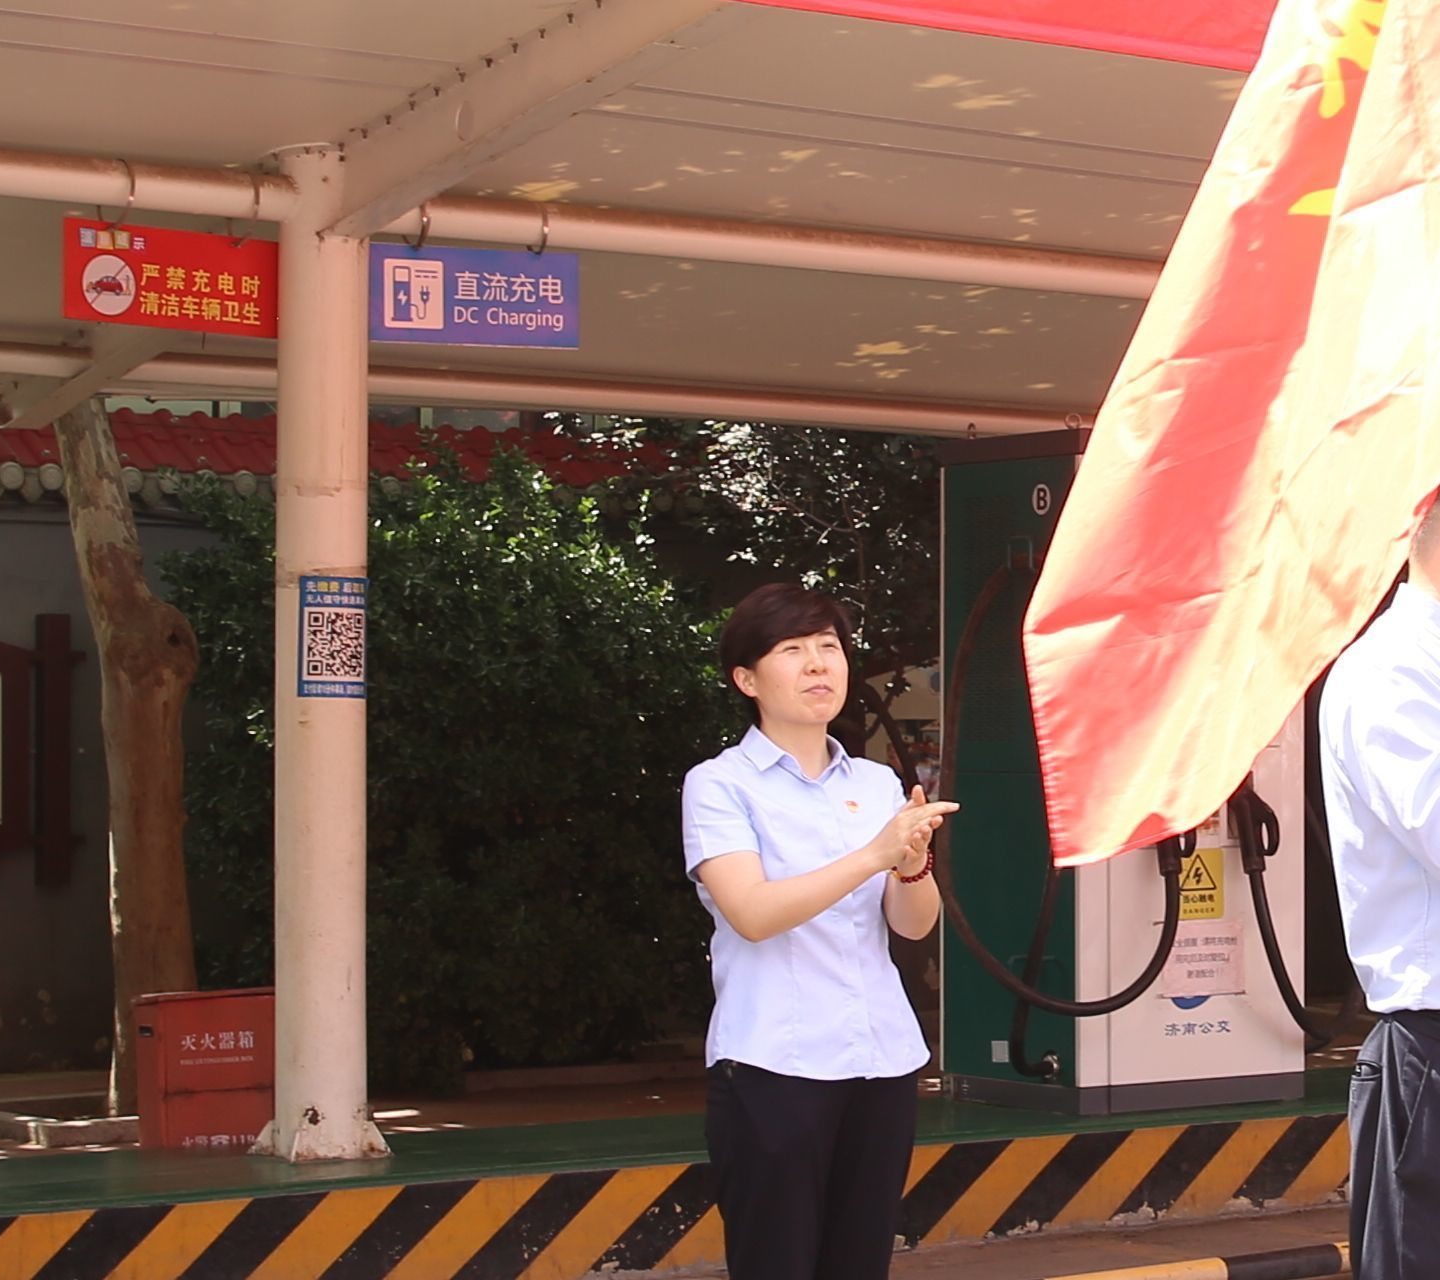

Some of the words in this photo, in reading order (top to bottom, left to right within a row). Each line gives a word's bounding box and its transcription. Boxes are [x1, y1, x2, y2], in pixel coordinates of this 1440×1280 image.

[140, 263, 261, 299] 严禁充电时
[453, 271, 565, 304] 直流充电
[140, 290, 262, 326] 清洁车辆卫生
[454, 306, 478, 325] DC
[486, 306, 564, 331] Charging
[181, 1030, 254, 1051] 灭火器箱
[1165, 1020, 1231, 1037] 济南公交
